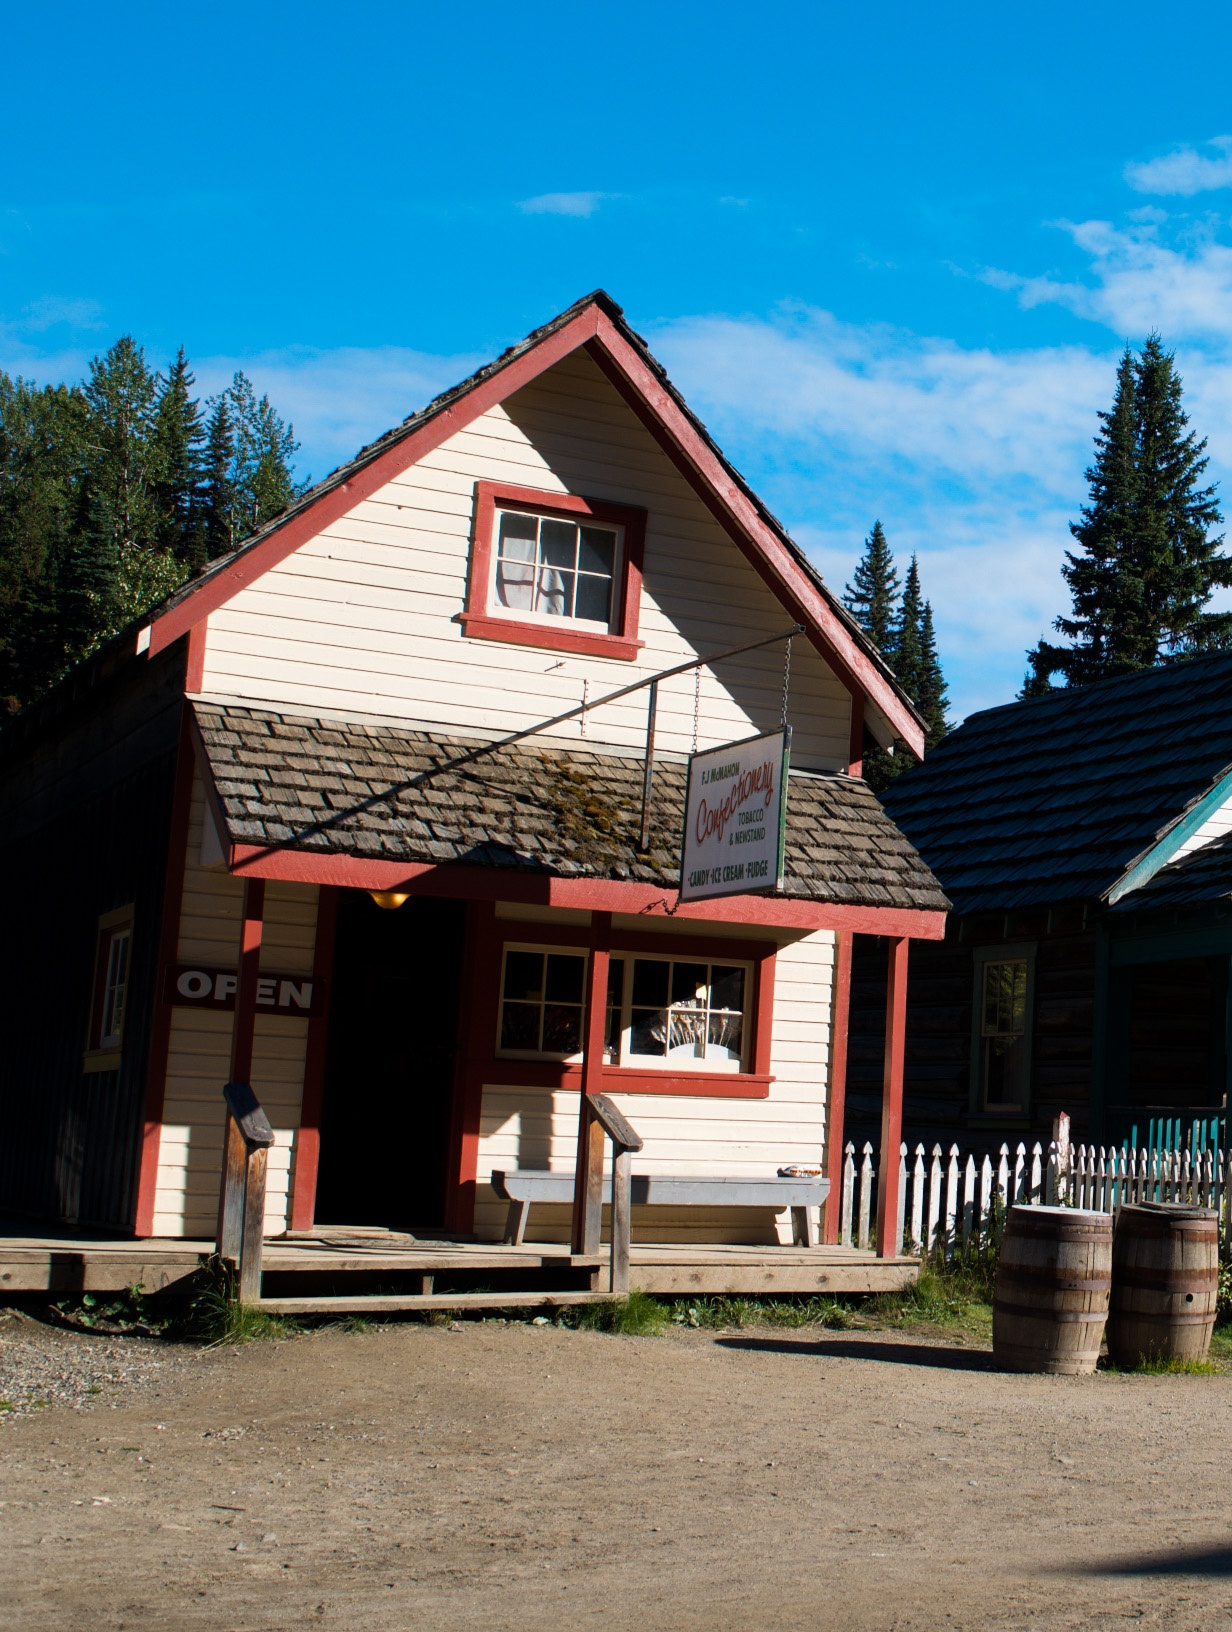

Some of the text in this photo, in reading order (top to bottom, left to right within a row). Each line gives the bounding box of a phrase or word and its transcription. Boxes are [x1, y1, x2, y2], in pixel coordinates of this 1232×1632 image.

[696, 761, 774, 845] Confectionery
[739, 808, 764, 827] TOBACCO
[729, 827, 766, 846] & NEWSTAND
[722, 863, 745, 883] CREAM
[176, 970, 314, 1010] OPEN
